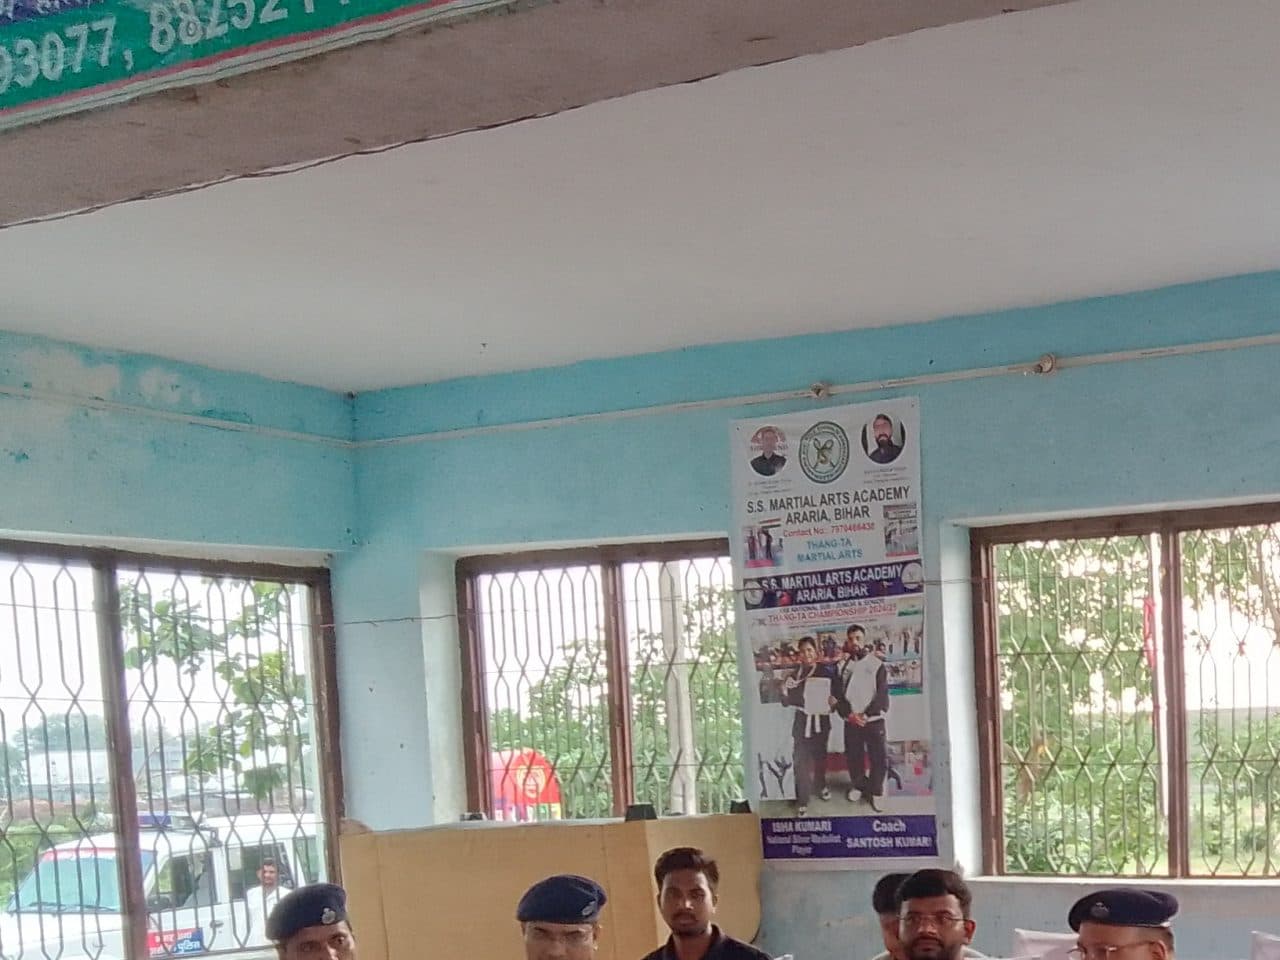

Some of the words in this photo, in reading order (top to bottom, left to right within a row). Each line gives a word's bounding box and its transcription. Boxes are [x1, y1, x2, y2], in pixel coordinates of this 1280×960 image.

[747, 500, 766, 513] S.S.
[769, 494, 817, 512] MARTIAL
[820, 491, 850, 507] ARTS
[853, 485, 910, 504] ACADEMY
[786, 509, 831, 525] ARARIA,
[834, 505, 870, 521] BIHAR
[783, 528, 812, 538] Contact
[797, 551, 837, 562] MARTIAL
[838, 549, 864, 560] ARTS
[782, 574, 824, 589] MARTIAL
[825, 571, 851, 584] ARTS
[853, 564, 903, 581] ACADEMY
[837, 584, 869, 598] BIHAR
[872, 820, 907, 833] Coach
[847, 837, 894, 848] SANTOSH
